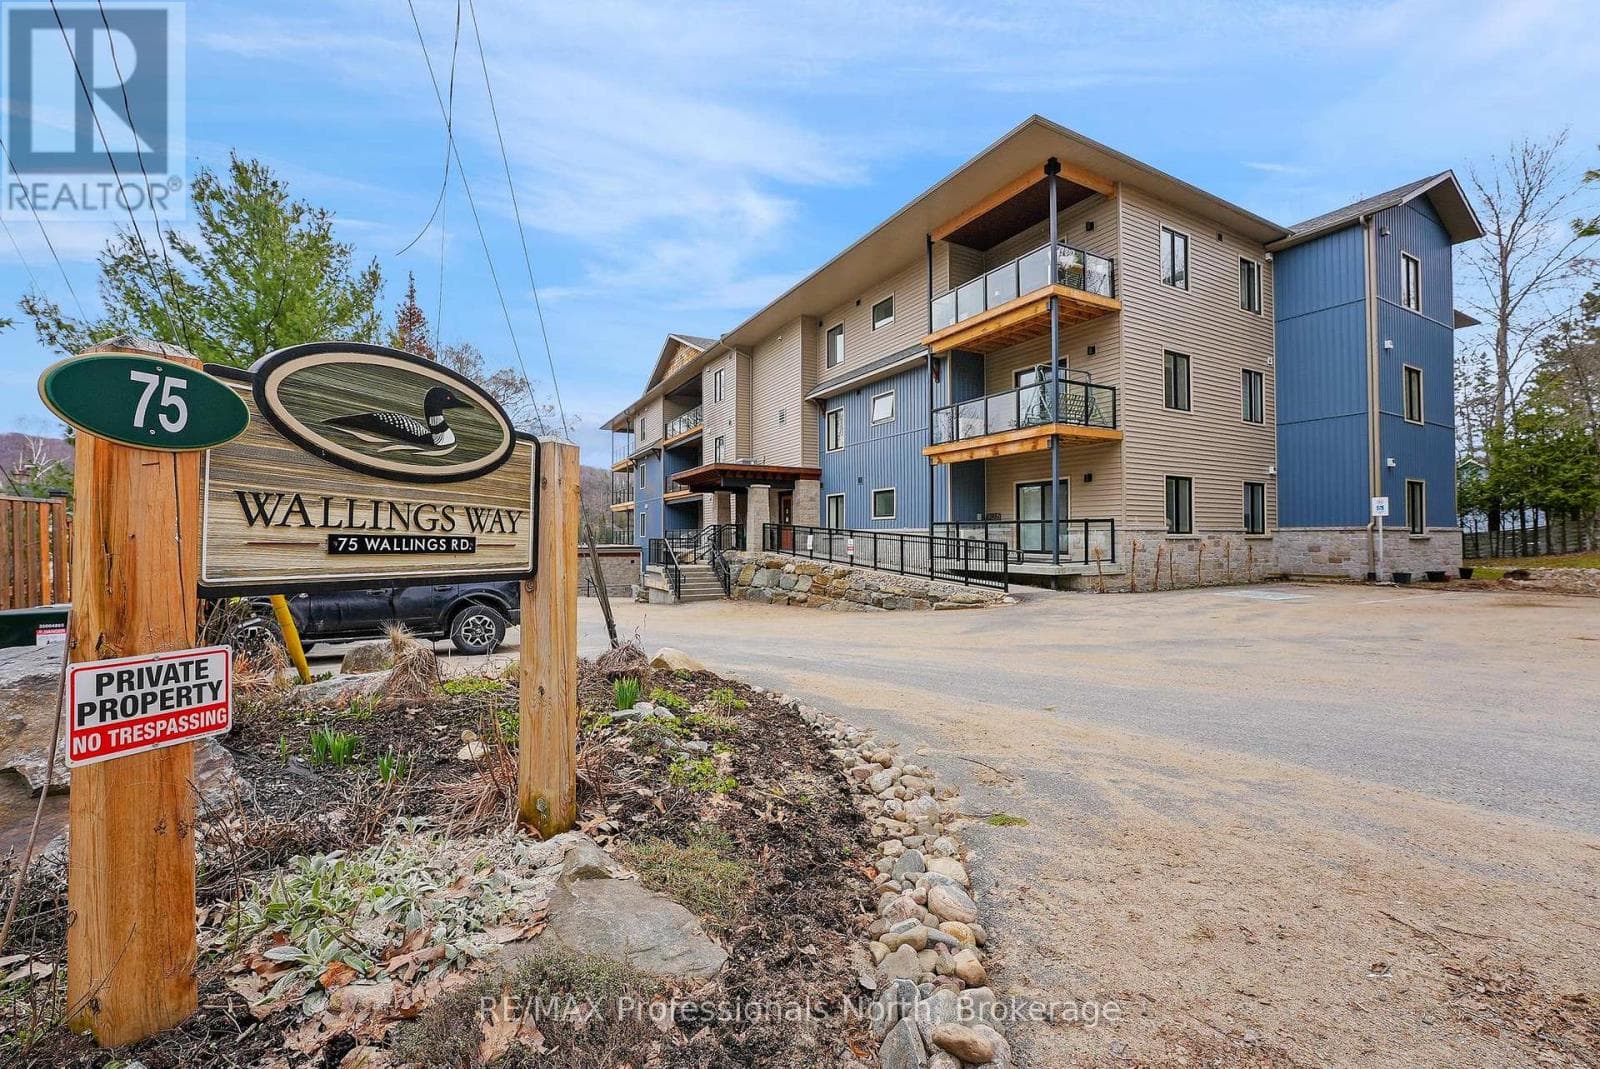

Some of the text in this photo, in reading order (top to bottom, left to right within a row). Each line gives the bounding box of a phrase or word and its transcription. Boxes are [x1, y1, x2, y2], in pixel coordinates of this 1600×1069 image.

[130, 369, 188, 433] 75
[234, 490, 524, 534] WALLINGS WAY
[337, 537, 472, 551] 75 WALLINGS RD.
[95, 658, 209, 697] PRIVATE
[77, 680, 223, 727] PROPERTY
[72, 707, 227, 755] NO TRESPASSING
